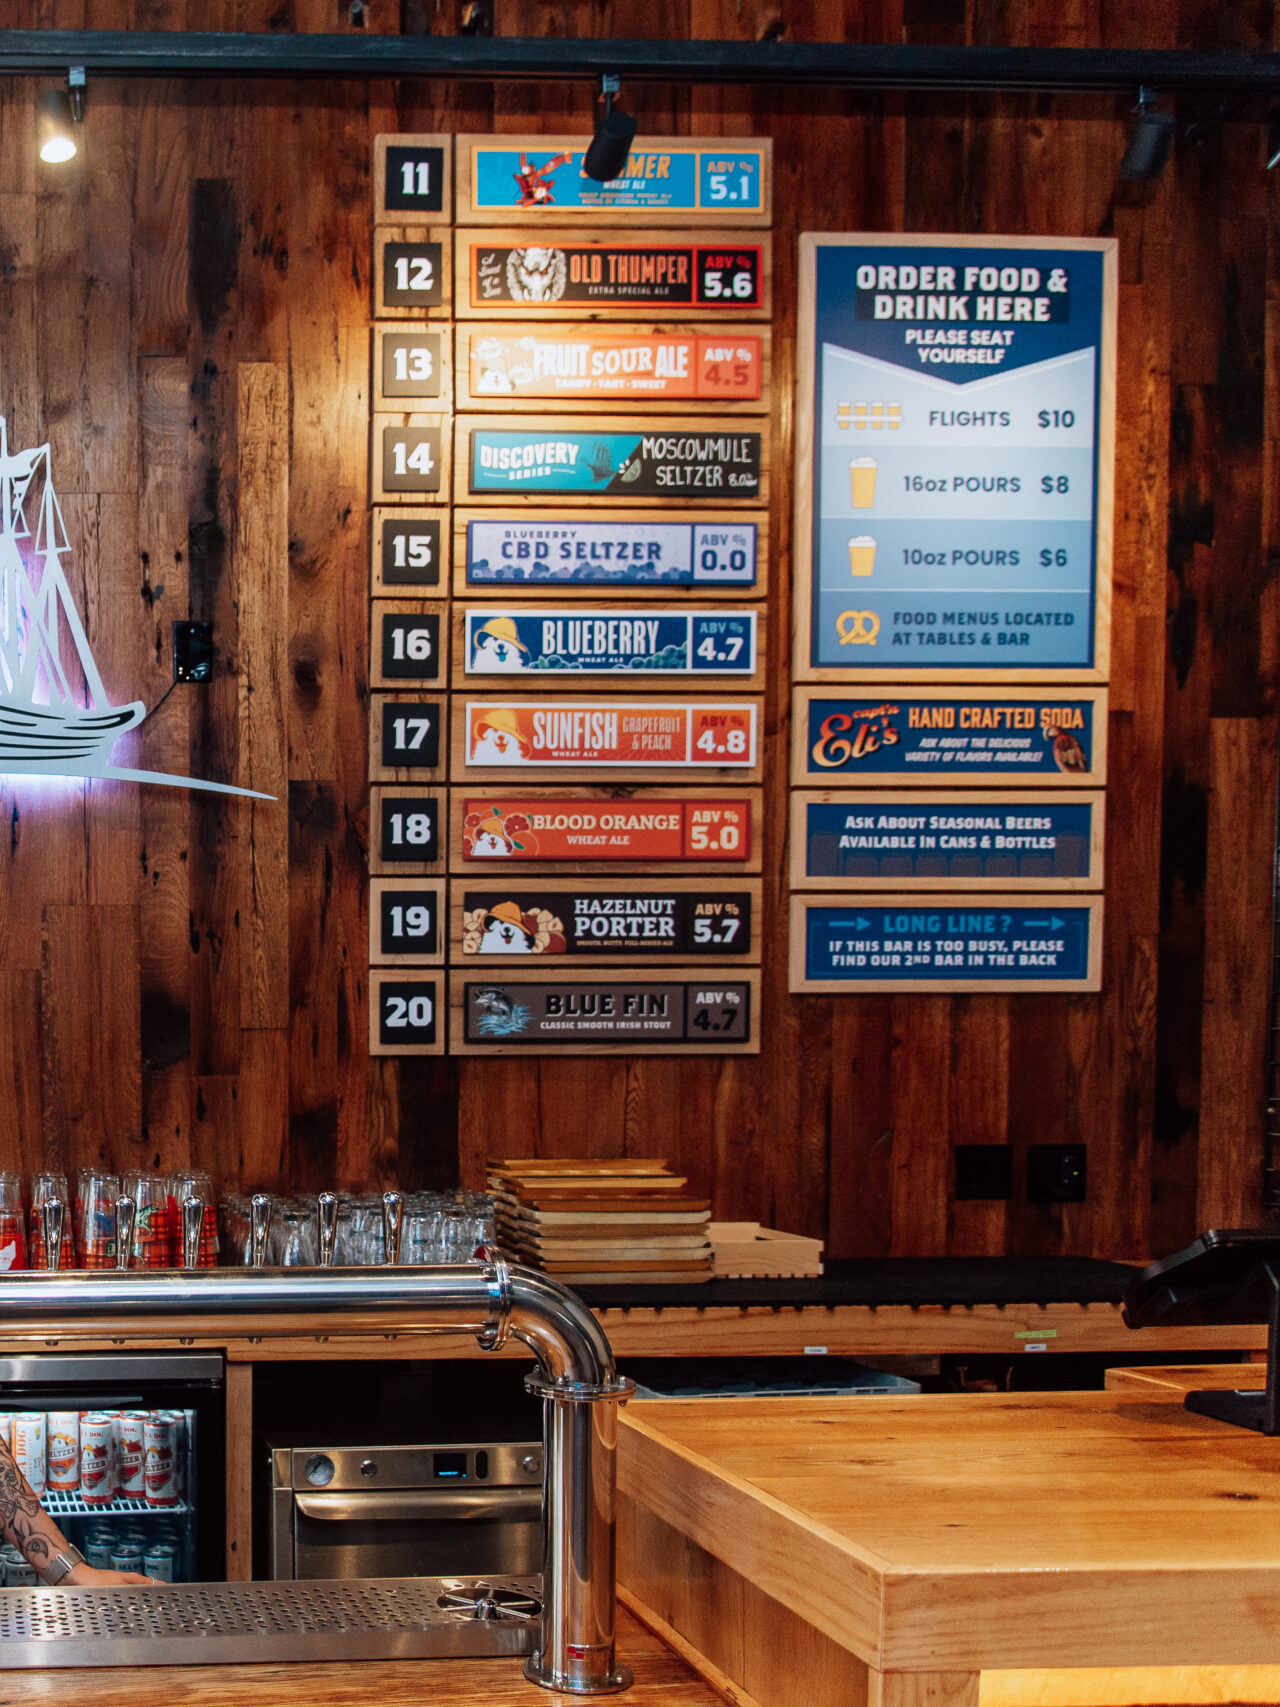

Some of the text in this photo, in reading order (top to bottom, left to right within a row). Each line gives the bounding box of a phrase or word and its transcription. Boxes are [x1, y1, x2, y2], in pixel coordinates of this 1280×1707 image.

[401, 162, 429, 195] 11
[579, 155, 671, 178] MER
[709, 176, 750, 200] 5.1
[394, 258, 434, 291] 12
[570, 254, 688, 284] OLD THUMPER
[704, 273, 753, 298] 5.6
[394, 348, 433, 382] 13
[533, 345, 688, 378] FRUIT SOUR ALE
[704, 364, 750, 387] 4.5
[928, 409, 1075, 429] FLIGHTS $10
[392, 442, 434, 476] 14
[480, 442, 579, 470] DISCOVERY
[509, 467, 551, 481] SERIES
[656, 465, 724, 488] SELTZER
[504, 530, 577, 539] BLUEBERRY
[392, 534, 432, 567] 15
[502, 541, 662, 561] CBD SELTZER
[701, 550, 746, 572] 0.0
[392, 629, 432, 661] 16
[542, 620, 659, 655] BLUEBERRY
[697, 637, 744, 662] 4.7
[393, 718, 431, 751] 17
[533, 711, 618, 751] SUNFISH
[623, 716, 681, 734] GRAPEFRUIT
[632, 735, 672, 751] & PEACH
[697, 730, 746, 755] 4.8
[390, 813, 431, 845] 18
[533, 814, 680, 831] BLOOD ORANGE
[845, 816, 1051, 830] ASK ABOUT SEASONAL BEERS
[567, 835, 630, 845] WHEAT ALE
[691, 826, 739, 850] 5.0
[839, 835, 1056, 849] AVAILABLE IN CANS & BOTTLES
[574, 899, 676, 915] HAZELNUT
[390, 906, 429, 937] 19
[575, 917, 676, 937] PORTER
[694, 919, 740, 944] 5.7
[385, 996, 432, 1028] 20
[545, 994, 668, 1018] BLUE FIN
[540, 1021, 671, 1030] CLASSIC SMOOTH IRISH STOUT
[692, 1008, 737, 1032] 4.7
